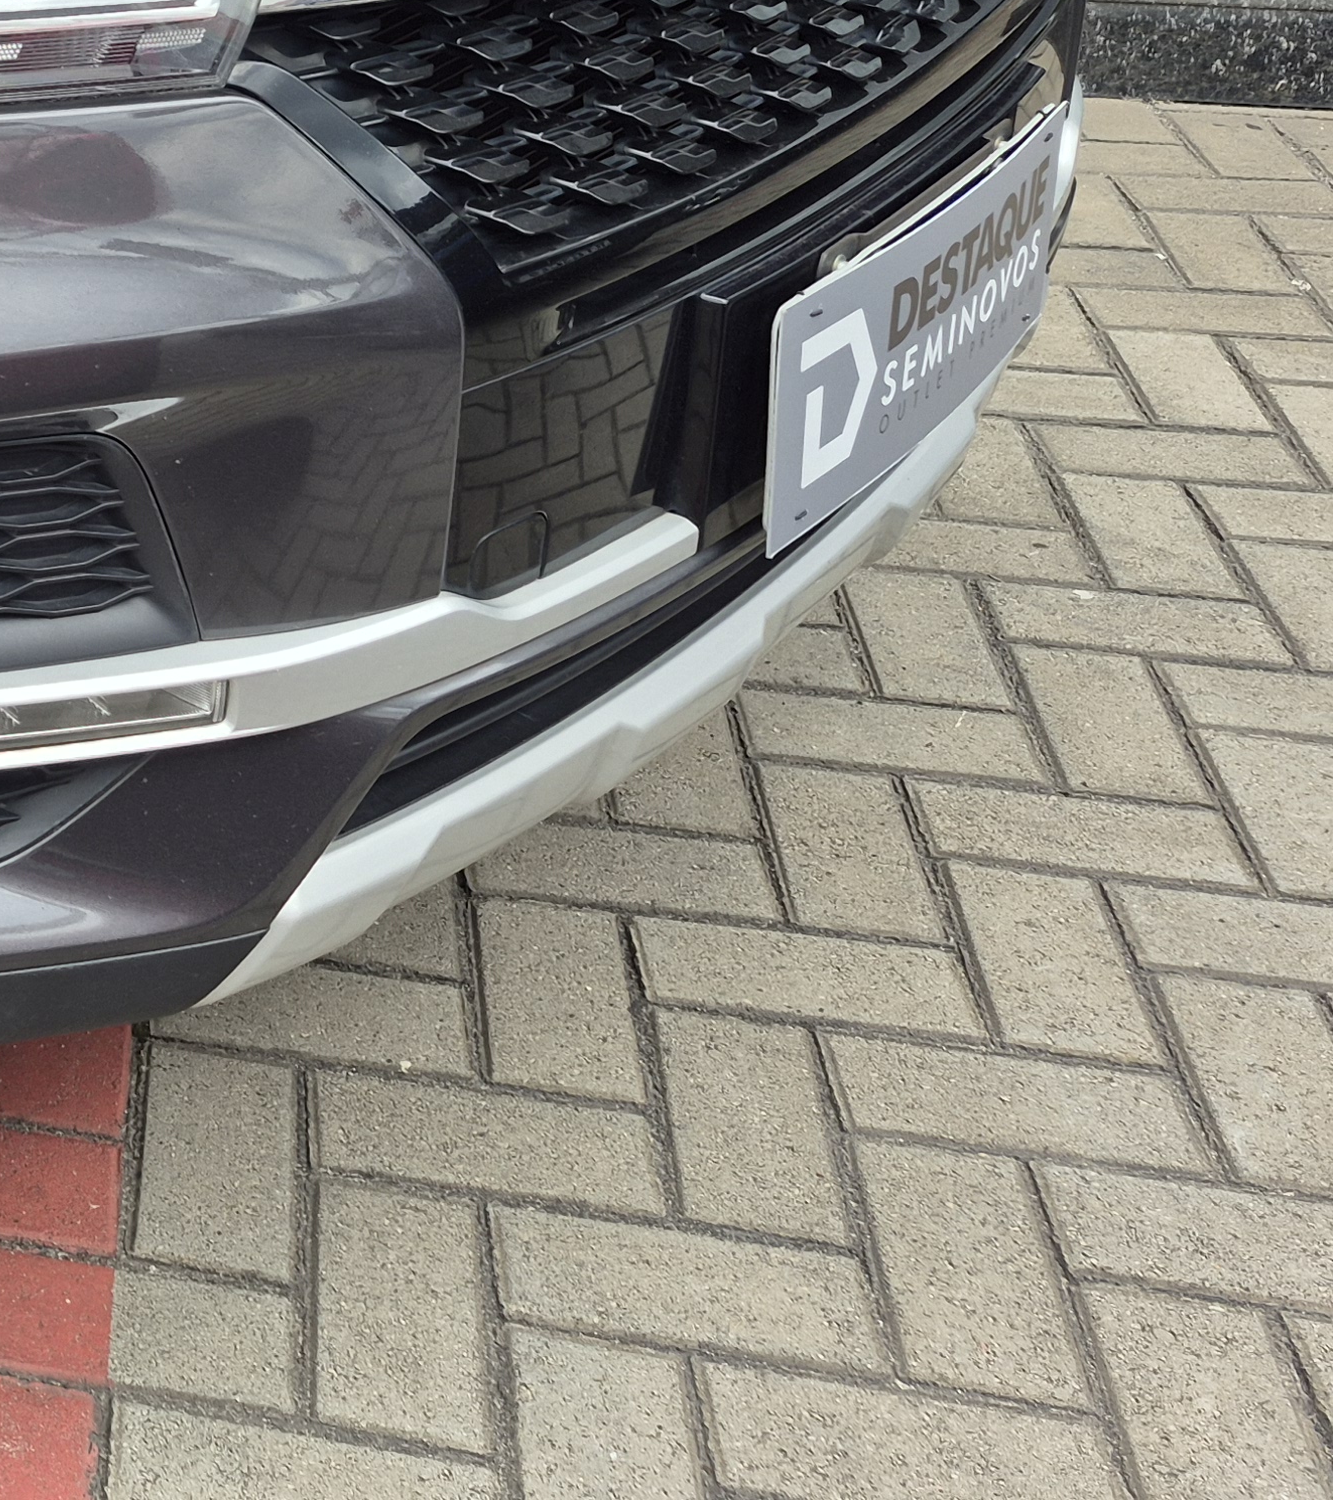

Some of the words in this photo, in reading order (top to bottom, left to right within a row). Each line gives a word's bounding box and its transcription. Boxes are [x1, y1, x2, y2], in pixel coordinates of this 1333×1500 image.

[880, 228, 1041, 407] SEMINOVOS
[887, 154, 1051, 352] DESTAQUE
[878, 359, 955, 435] OUTLET
